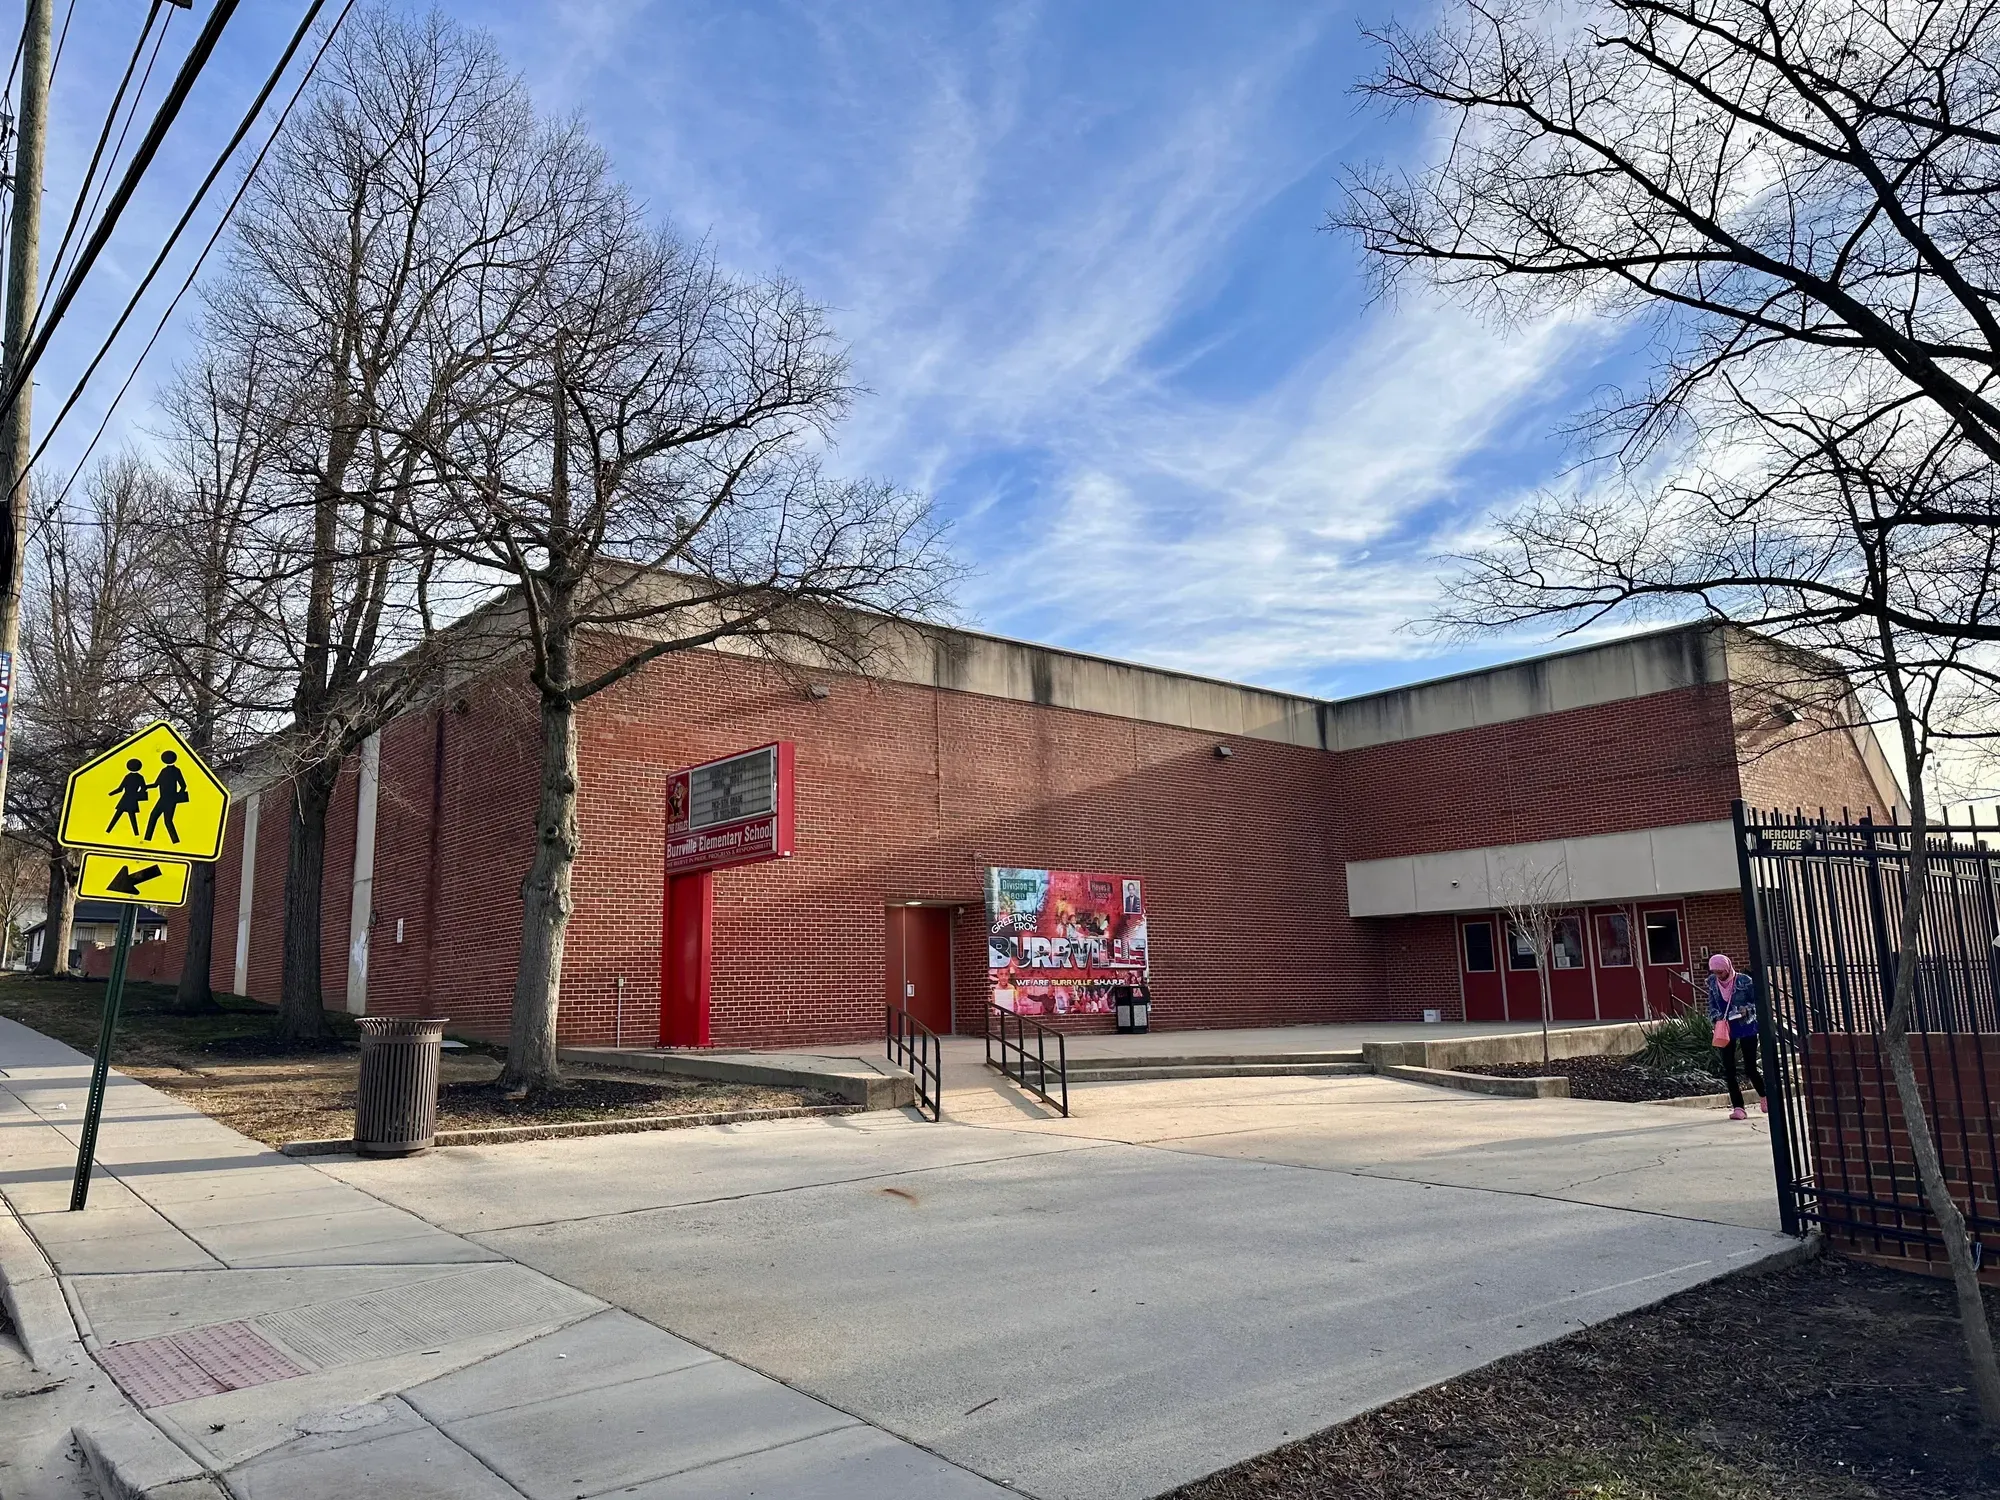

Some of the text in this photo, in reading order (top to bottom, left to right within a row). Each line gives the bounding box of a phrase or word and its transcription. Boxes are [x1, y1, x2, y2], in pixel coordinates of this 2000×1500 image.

[675, 821, 688, 832] EAGLES
[667, 821, 772, 859] Burrville Elementary School
[1762, 829, 1812, 840] HERCULES
[1771, 840, 1802, 851] FENCE
[1002, 879, 1028, 891] Division
[1010, 892, 1025, 900] 800
[991, 912, 1037, 934] GREETINGS
[1014, 922, 1037, 933] FROM
[988, 936, 1147, 969] BURRVILLE
[1051, 979, 1092, 987] BURRVILLE
